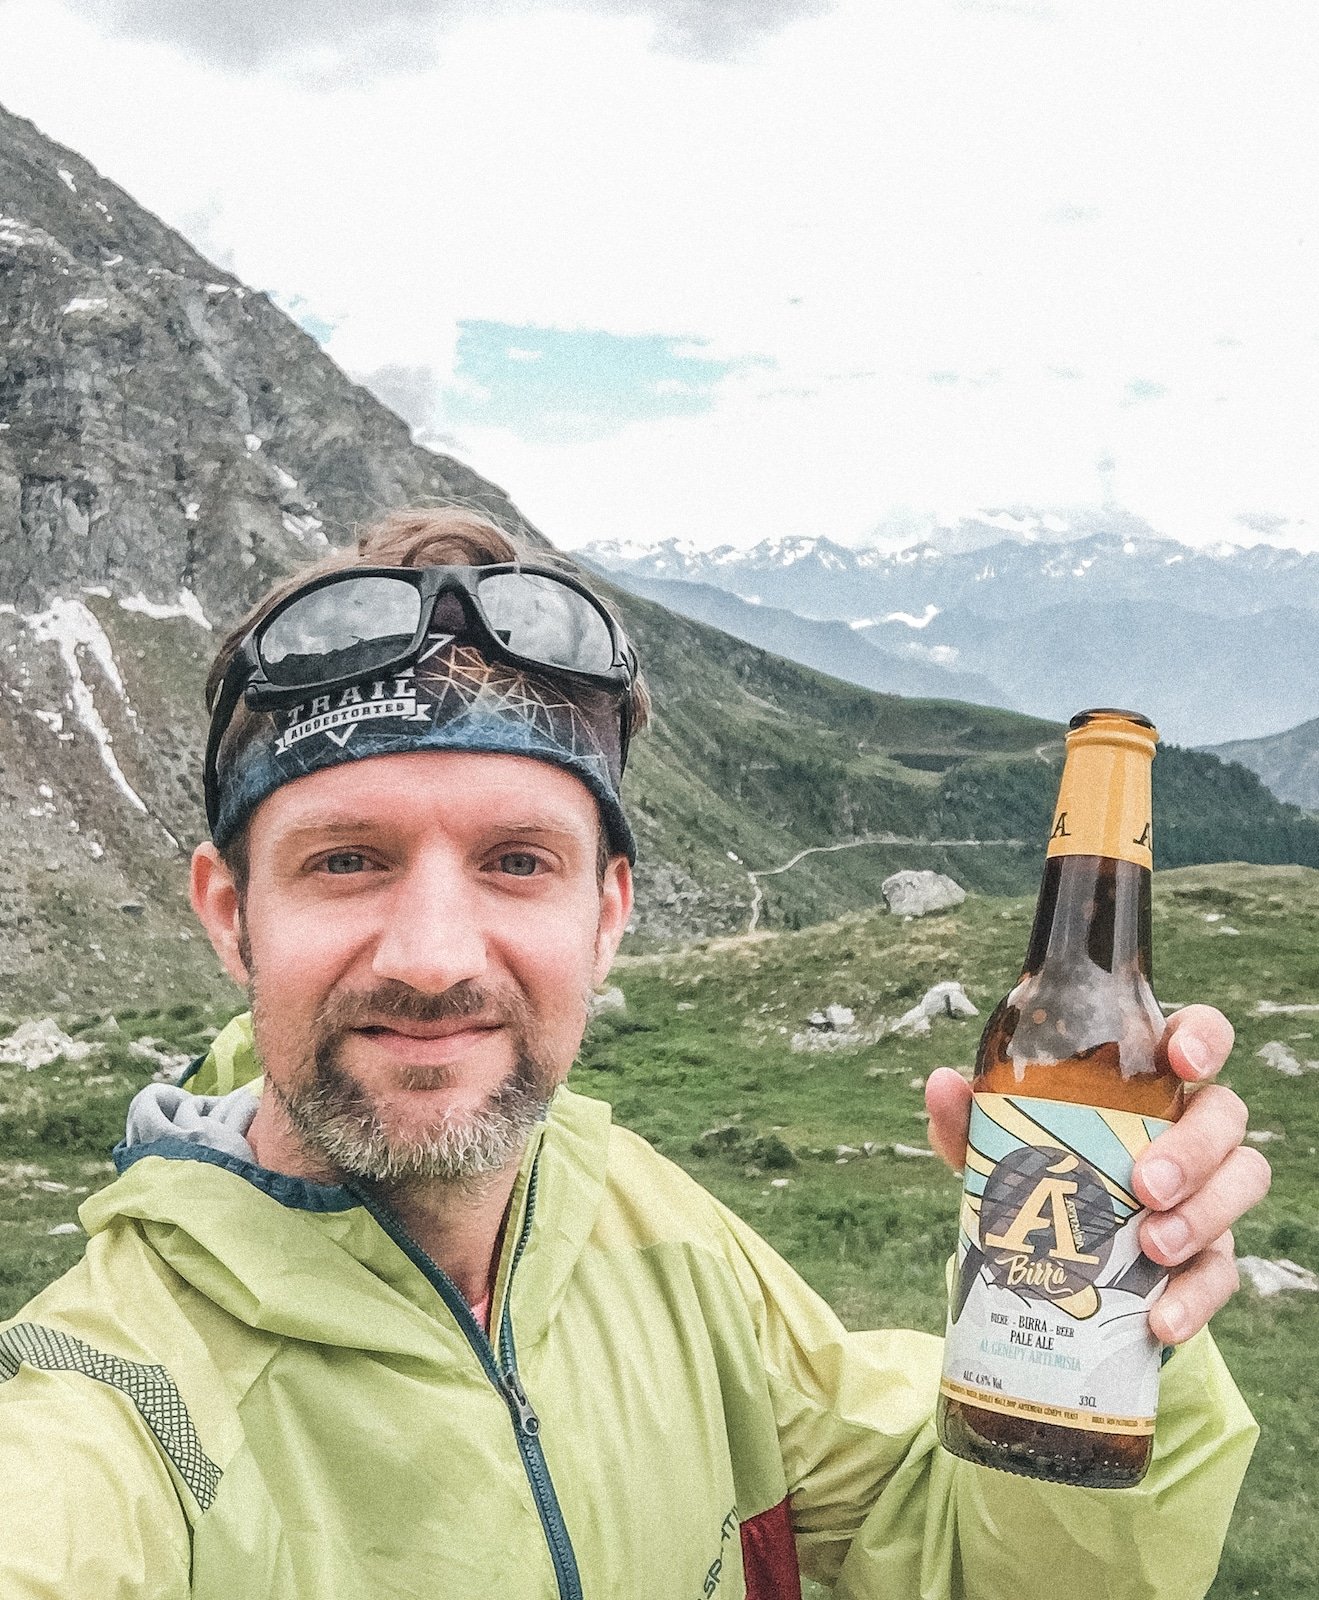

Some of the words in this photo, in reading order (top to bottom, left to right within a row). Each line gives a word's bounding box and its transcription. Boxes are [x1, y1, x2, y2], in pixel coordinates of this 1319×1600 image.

[287, 679, 417, 727] TRAIL
[1049, 811, 1072, 841] A
[1018, 1315, 1048, 1333] BIRRA
[1055, 1325, 1075, 1338] BEER
[1010, 1329, 1033, 1347] PALE
[1035, 1336, 1055, 1351] ALE
